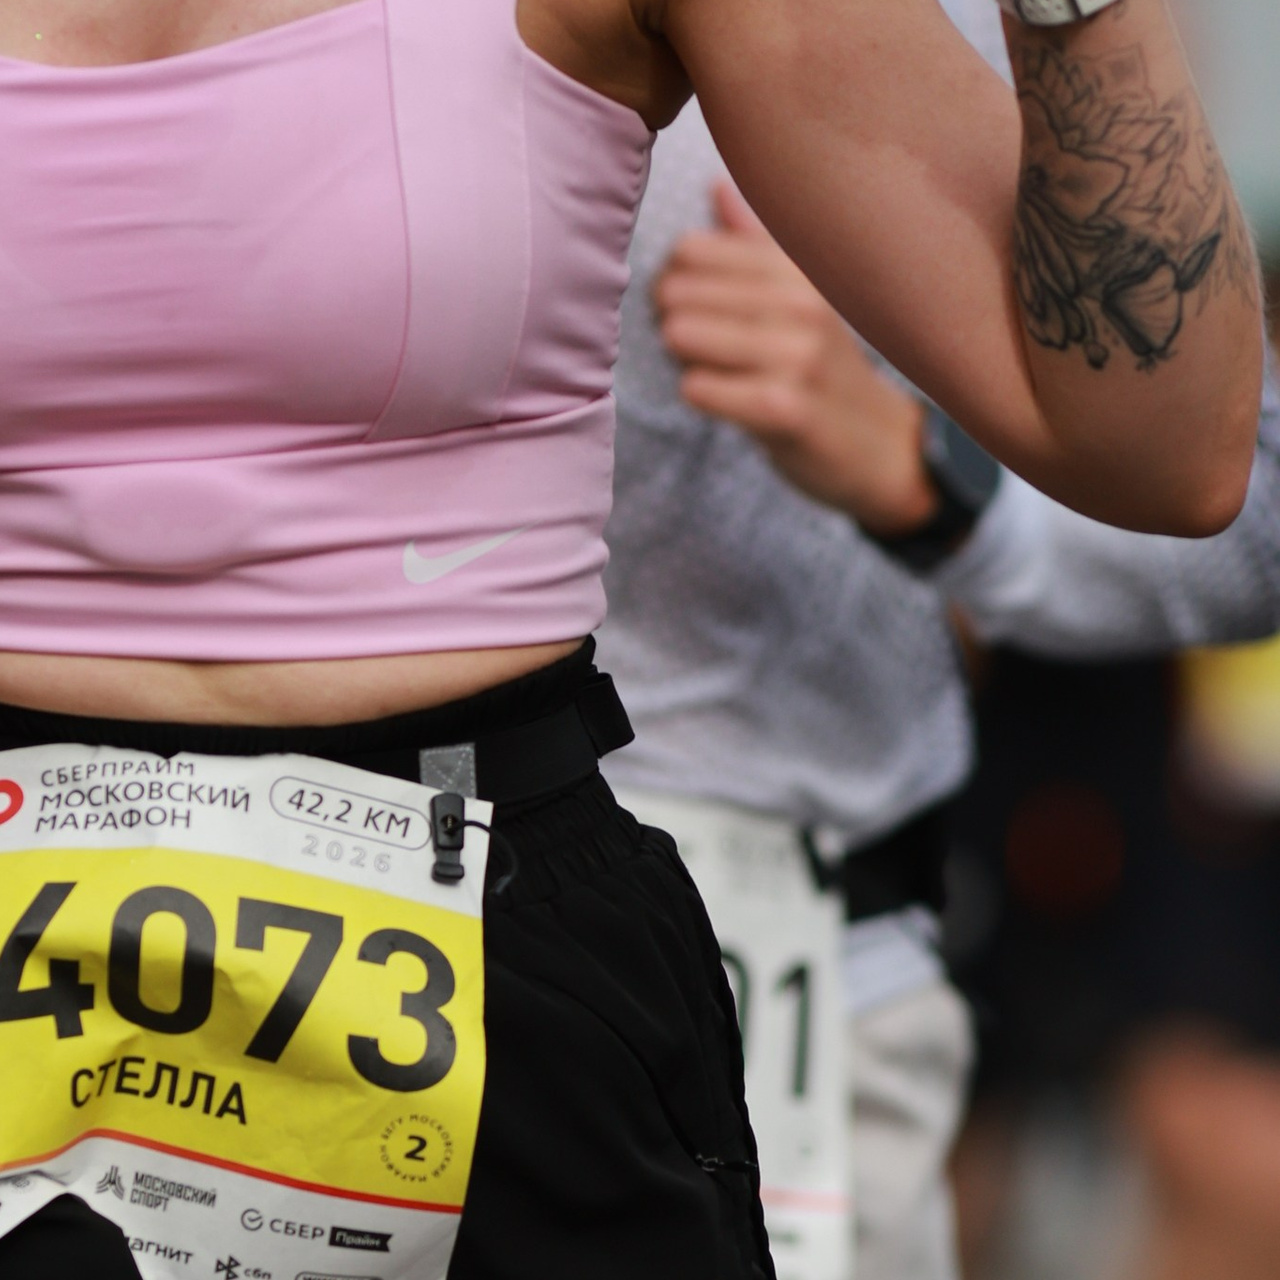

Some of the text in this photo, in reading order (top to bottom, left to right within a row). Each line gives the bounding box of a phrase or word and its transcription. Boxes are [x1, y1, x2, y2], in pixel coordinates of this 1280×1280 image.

[41, 759, 195, 787] СБЕРПРАЙМ
[40, 780, 251, 812] МОСКОВСКИЙ
[288, 789, 352, 823] 42,2
[35, 806, 191, 833] МАРАФОН
[301, 833, 392, 873] 2026
[70, 1056, 248, 1126] СТЕЛЛА
[404, 1134, 427, 1162] 2
[129, 1189, 170, 1212] СПОРТ
[133, 1171, 216, 1209] МОСКОВСКИЙ
[269, 1218, 324, 1240] СБЕР
[124, 1236, 194, 1265] агнит
